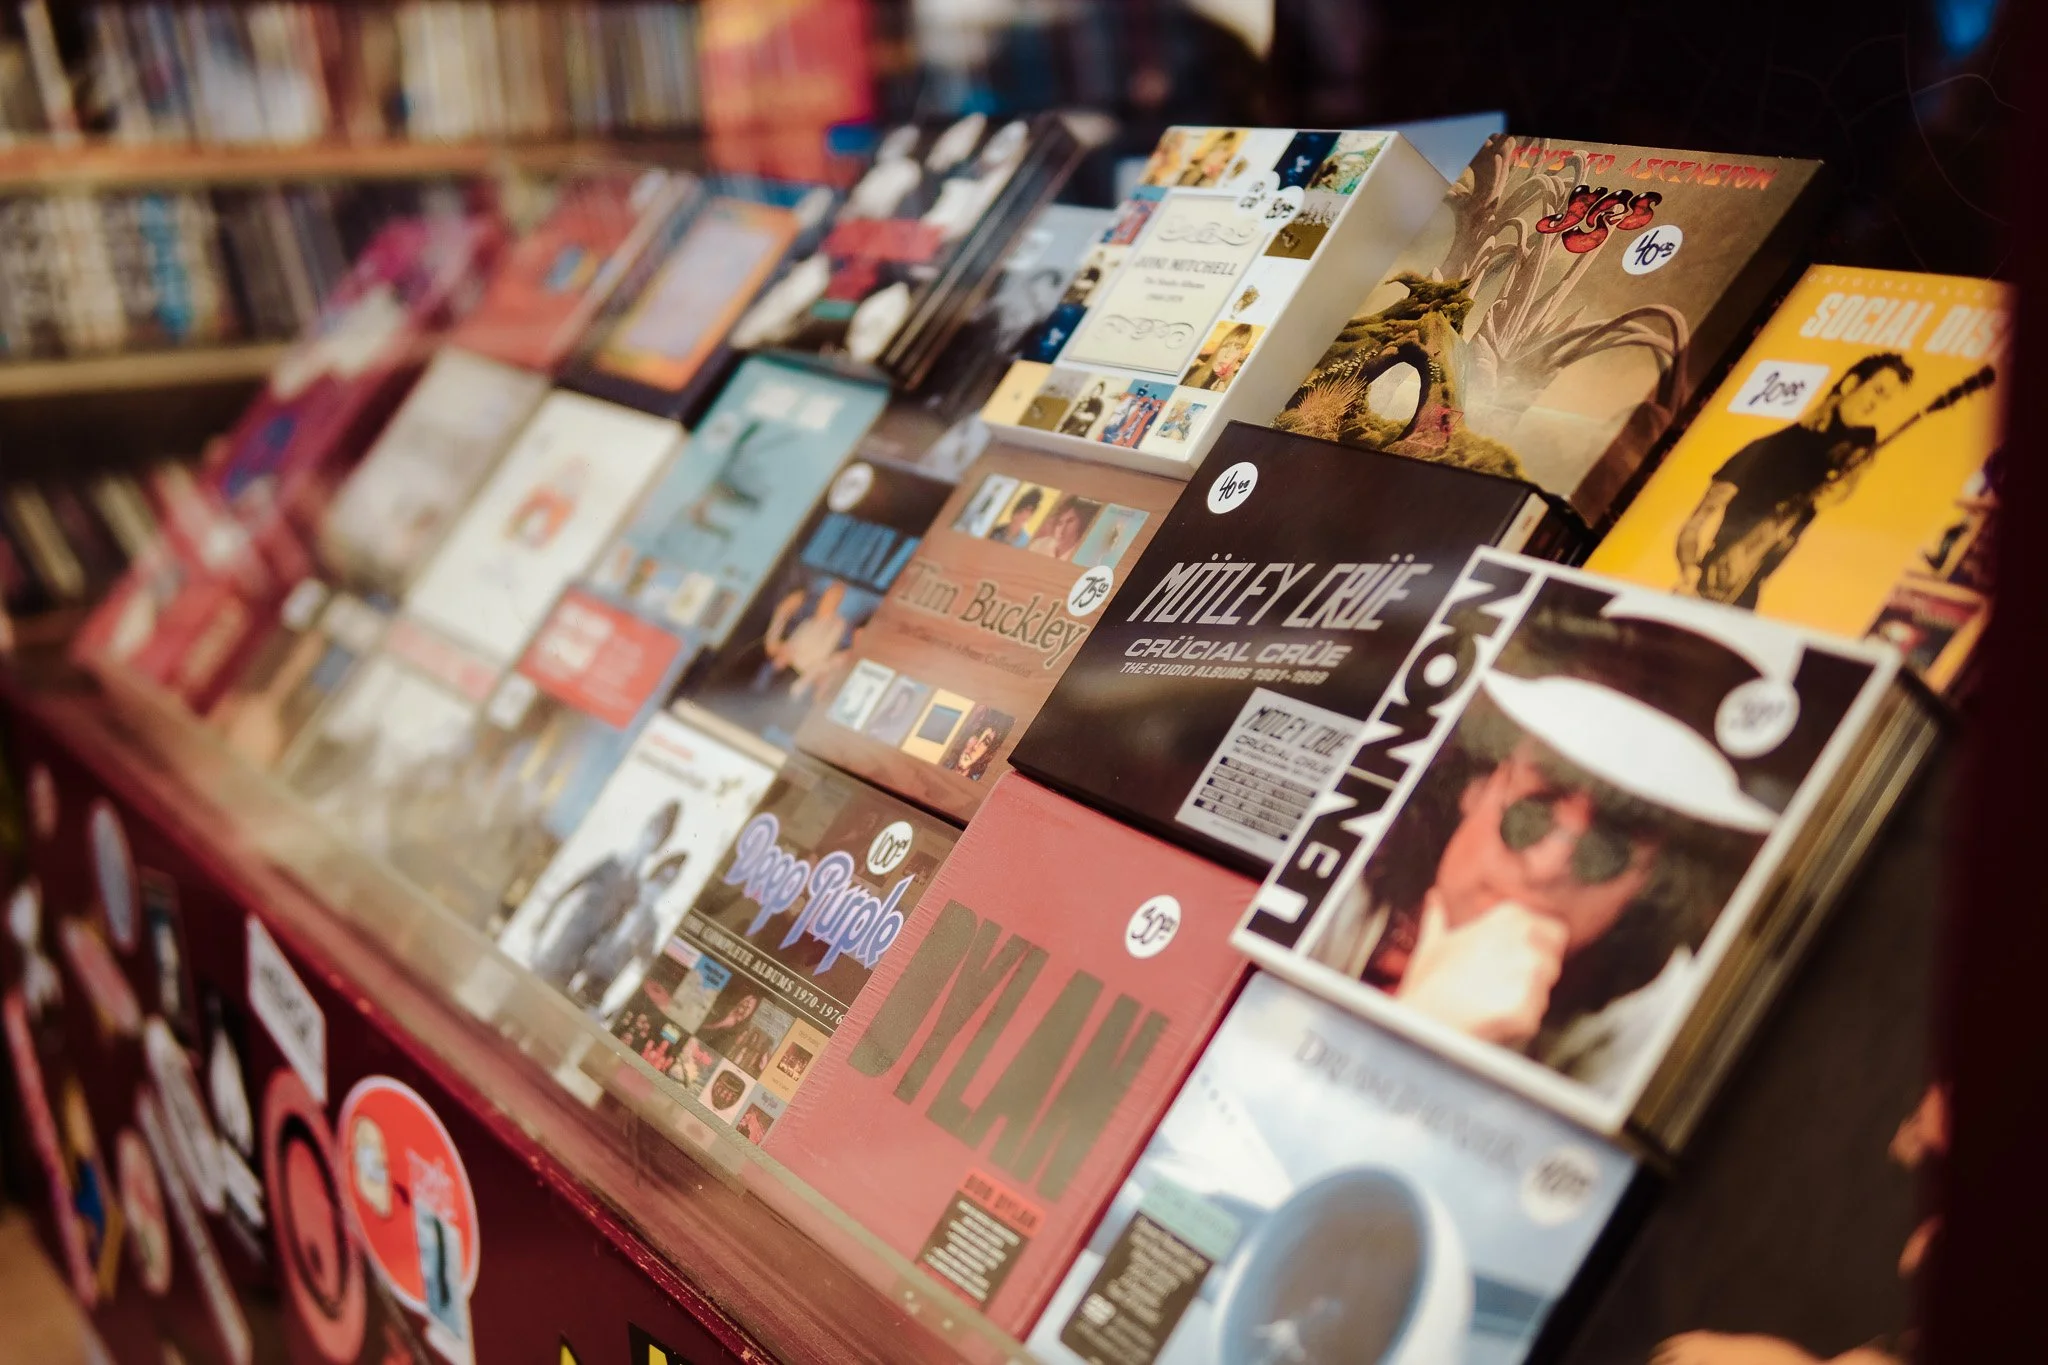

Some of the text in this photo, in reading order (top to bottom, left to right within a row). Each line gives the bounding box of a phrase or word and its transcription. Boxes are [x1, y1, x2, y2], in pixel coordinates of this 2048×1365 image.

[1587, 152, 1616, 175] TO
[1623, 157, 1779, 191] ASCENSION
[1169, 258, 1238, 276] MITCHELL
[1798, 292, 1936, 351] SOCIAL
[898, 557, 1089, 669] Tim Buckley
[1126, 553, 1434, 630] MÖTLEY CRÜE
[1119, 661, 1149, 674] THE
[1143, 662, 1196, 677] STUDIO
[1191, 665, 1253, 681] ALBUMS
[1124, 635, 1353, 668] CRÜCIAL CRÜE
[724, 812, 916, 977] Deep Purple
[751, 959, 796, 993] ALBUMS
[792, 986, 845, 1026] 1970-1976
[846, 897, 1171, 1205] DYLAN
